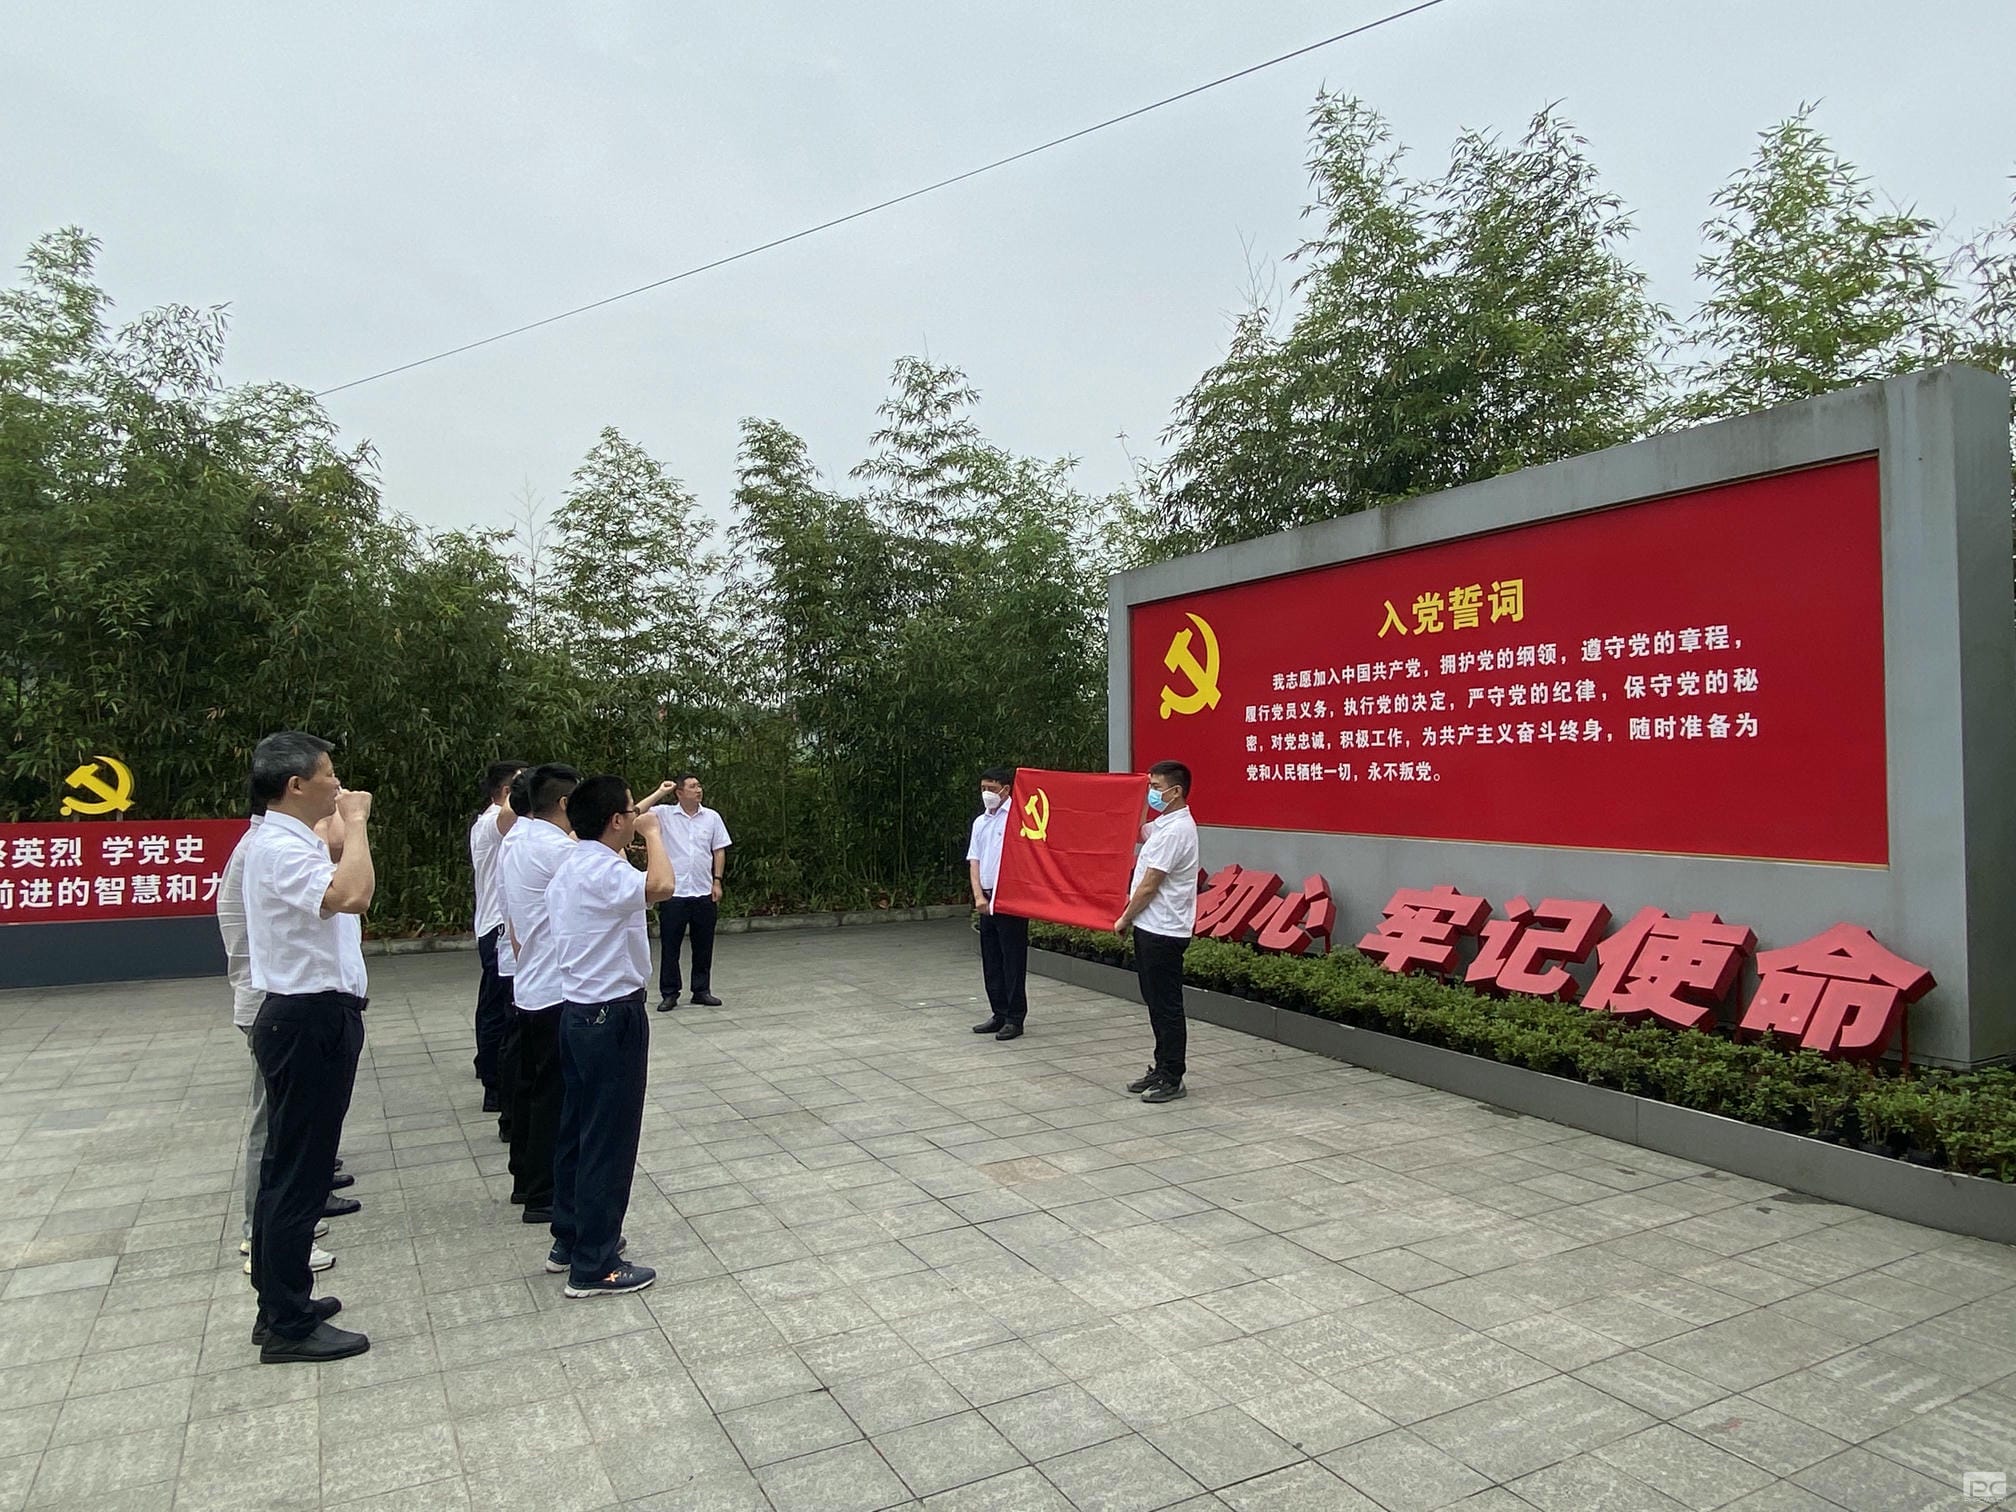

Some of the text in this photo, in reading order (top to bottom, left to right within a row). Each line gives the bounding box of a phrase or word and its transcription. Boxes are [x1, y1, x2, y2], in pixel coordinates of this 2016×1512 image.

[1377, 578, 1525, 638] 入党誓词
[0, 834, 205, 869] 英烈 学党史
[1356, 884, 1936, 1056] 牢记使命
